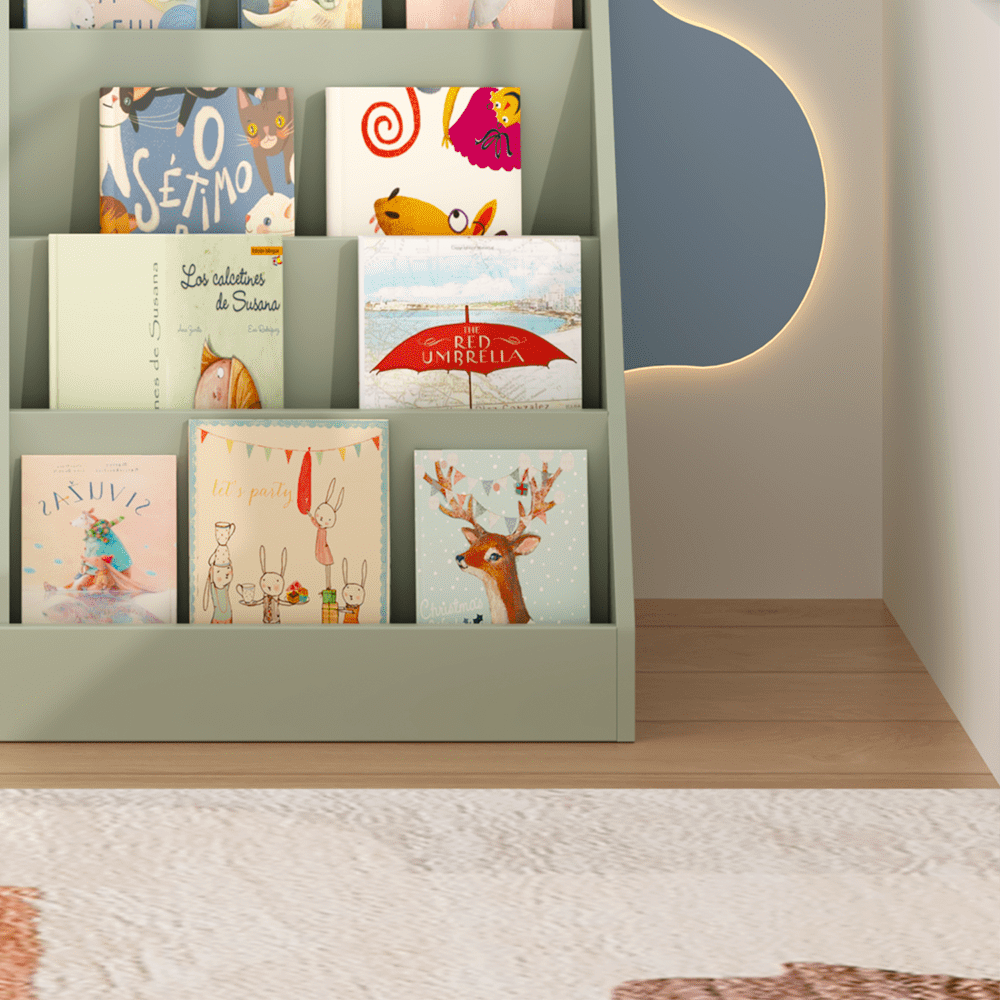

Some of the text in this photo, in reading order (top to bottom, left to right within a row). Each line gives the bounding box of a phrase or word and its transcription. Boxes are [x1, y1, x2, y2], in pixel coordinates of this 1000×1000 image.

[193, 105, 225, 170] O
[180, 263, 265, 290] Los calcetines
[149, 262, 161, 341] Susana
[216, 290, 280, 312] de Susana
[463, 326, 481, 334] THE
[454, 335, 491, 350] RED
[149, 347, 160, 371] de
[422, 349, 525, 366] UMBRELLA
[212, 478, 293, 509] let's party
[420, 597, 484, 620] Christmas
